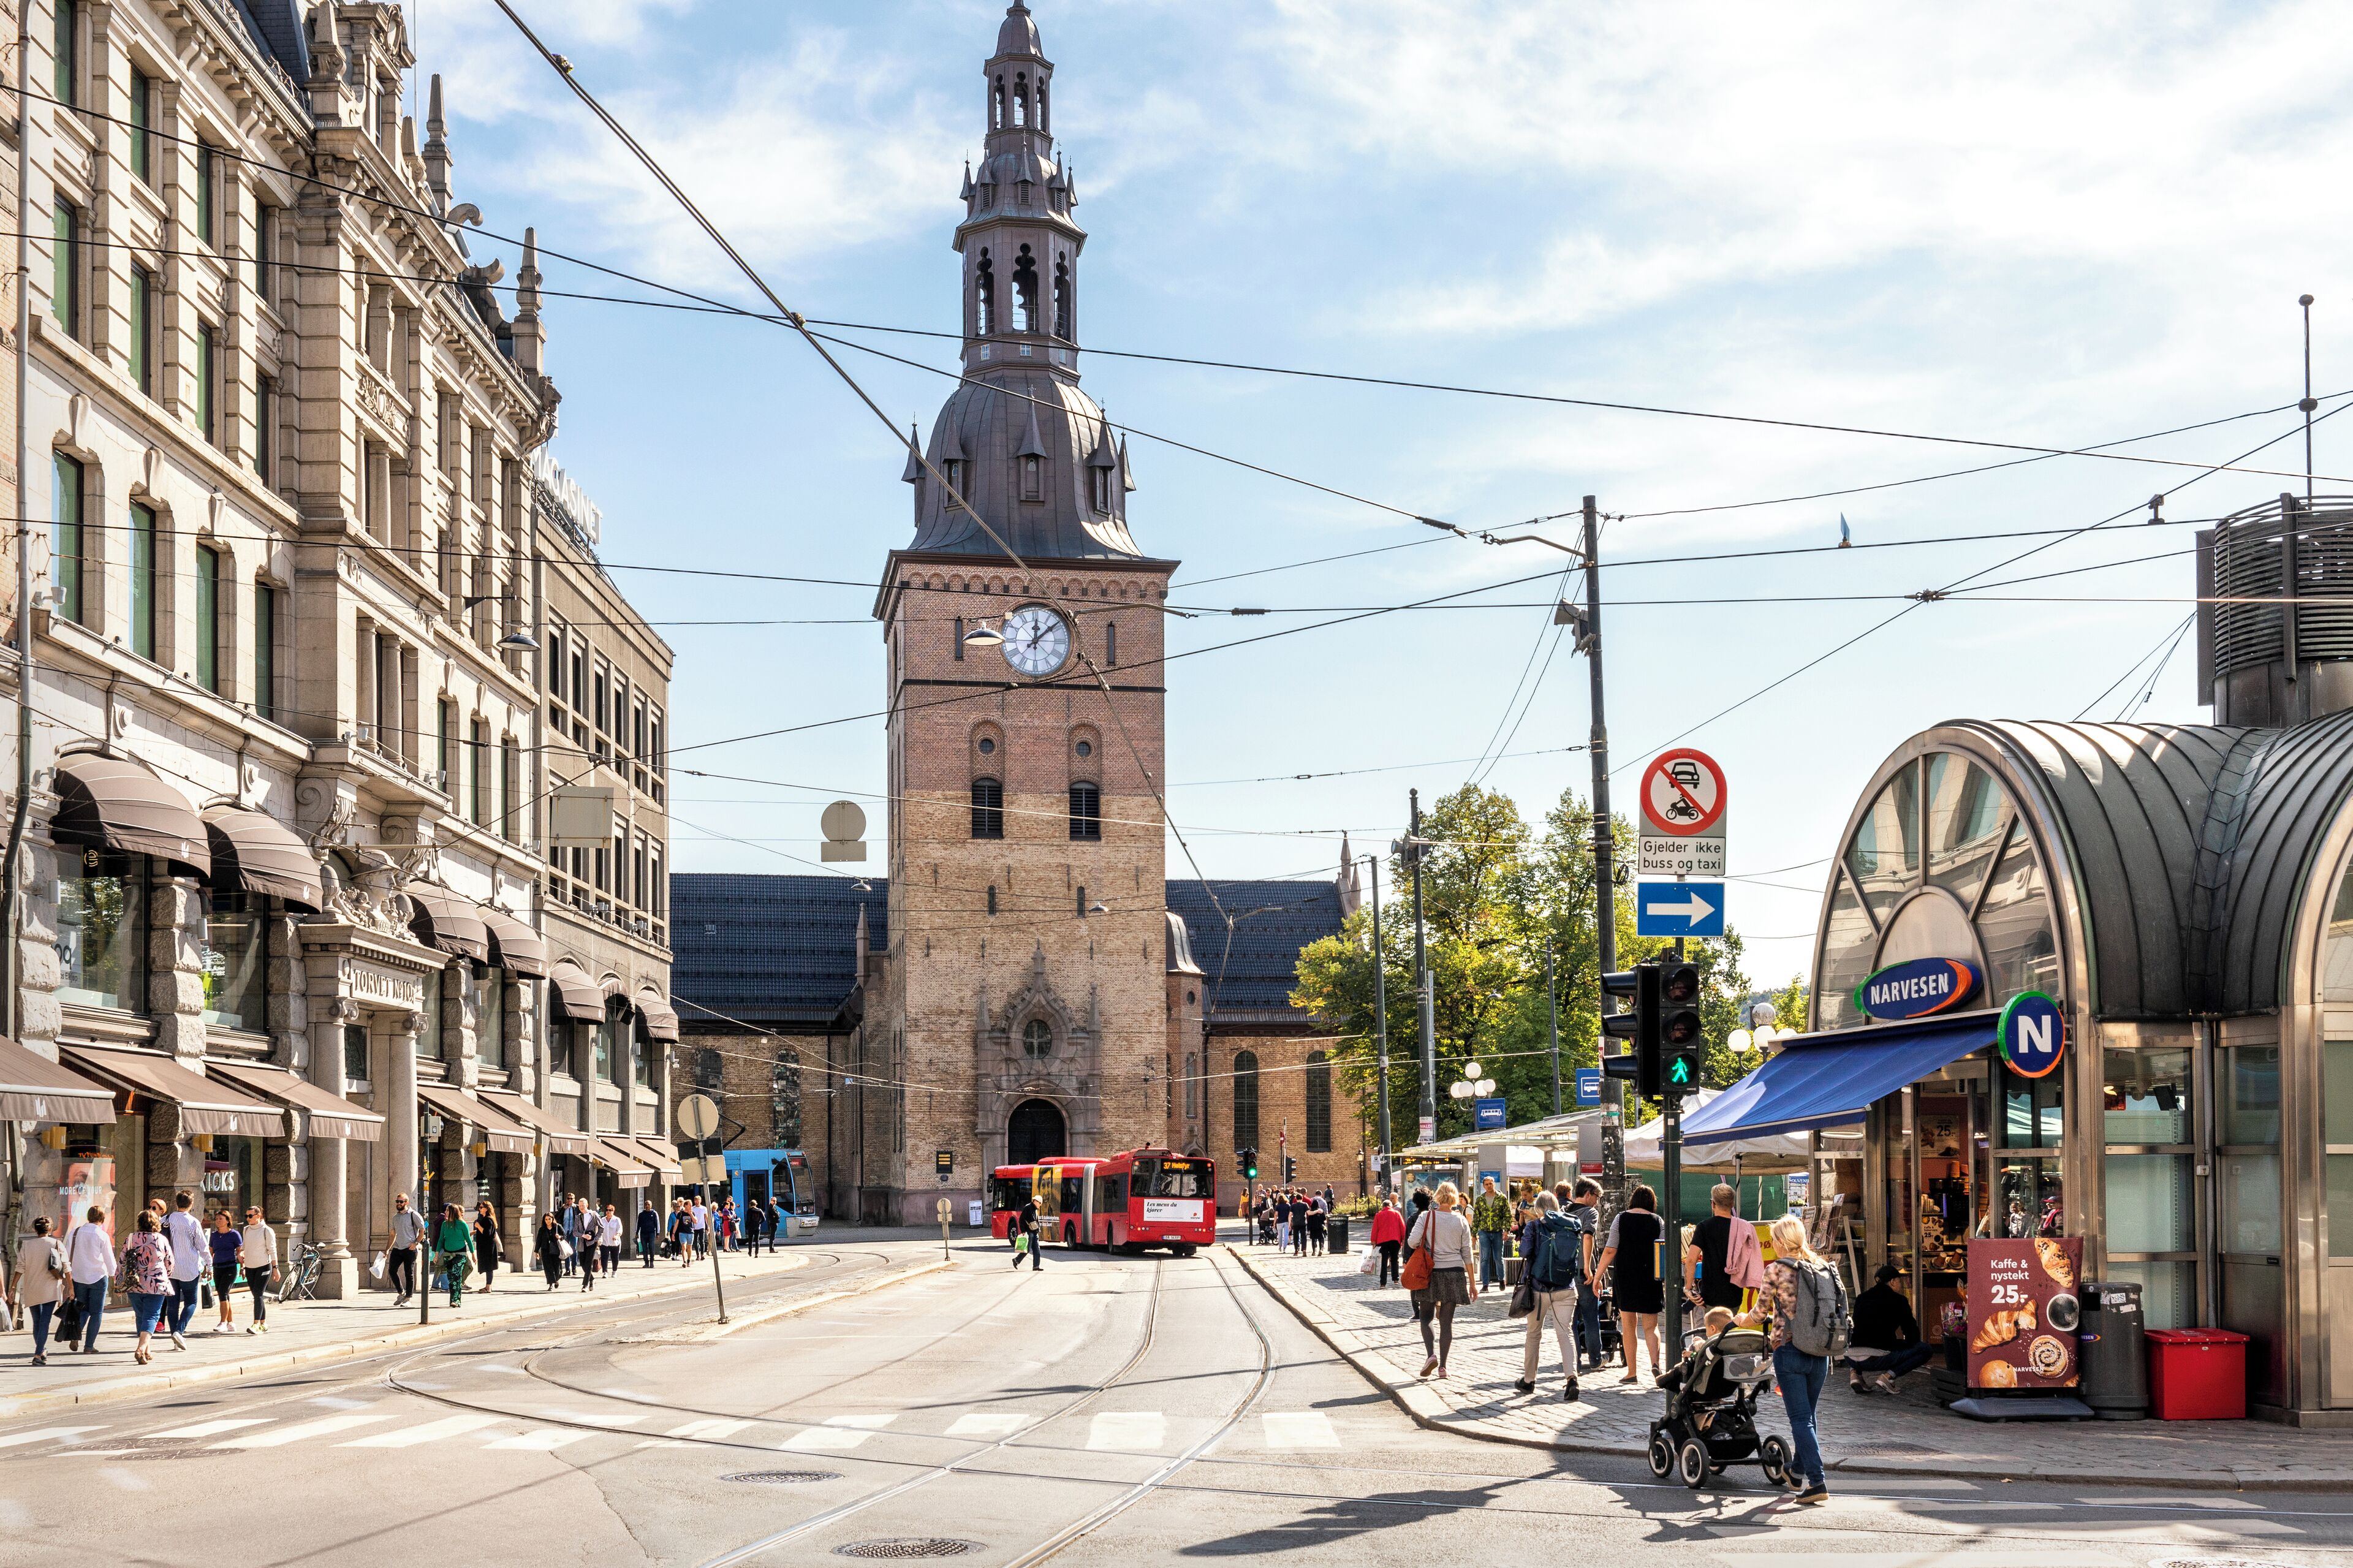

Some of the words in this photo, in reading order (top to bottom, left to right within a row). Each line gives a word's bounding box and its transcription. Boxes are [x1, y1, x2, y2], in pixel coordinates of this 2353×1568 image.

[530, 445, 603, 545] MAGASINET
[1643, 841, 1688, 855] Gjelder
[1696, 842, 1721, 854] ikke
[1643, 858, 1673, 868] buss
[1678, 860, 1692, 871] og
[1697, 858, 1721, 869] taxi
[354, 969, 392, 998] TORVET
[1870, 972, 1949, 1005] NARVESEN
[2018, 1015, 2052, 1053] N
[59, 1186, 75, 1195] MORE
[87, 1186, 102, 1194] YOUR
[1991, 1259, 2017, 1269] Kaffe
[2020, 1260, 2028, 1269] &
[1991, 1270, 2029, 1282] nystekt
